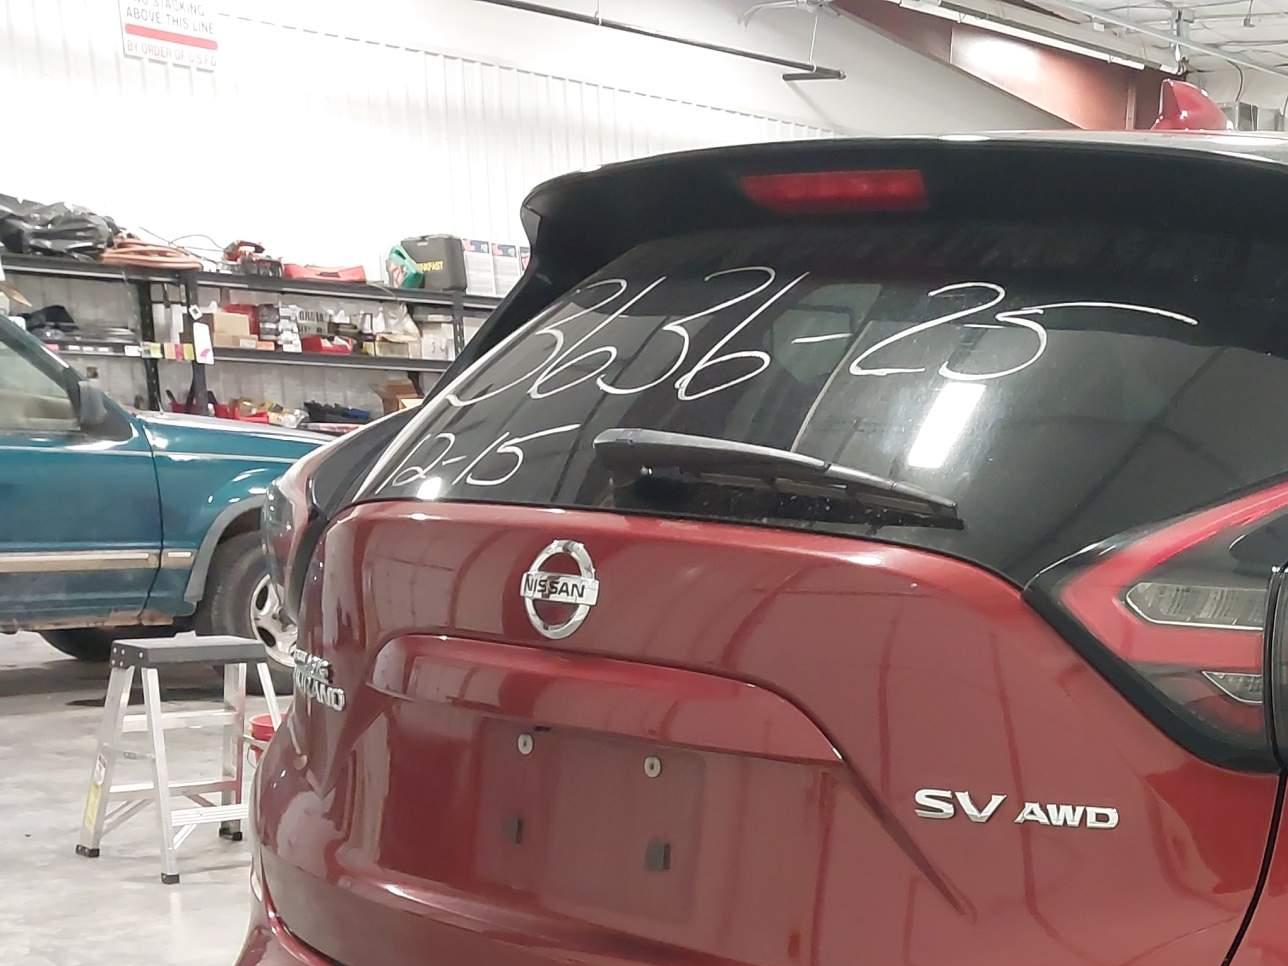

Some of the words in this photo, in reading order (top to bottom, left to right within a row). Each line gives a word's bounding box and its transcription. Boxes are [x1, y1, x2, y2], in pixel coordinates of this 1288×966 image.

[126, 6, 161, 24] ABOVE
[165, 13, 189, 30] THIS
[193, 21, 215, 34] LINE
[523, 572, 586, 599] NISSAN
[914, 788, 1008, 823] SV
[1013, 801, 1120, 830] AWD
